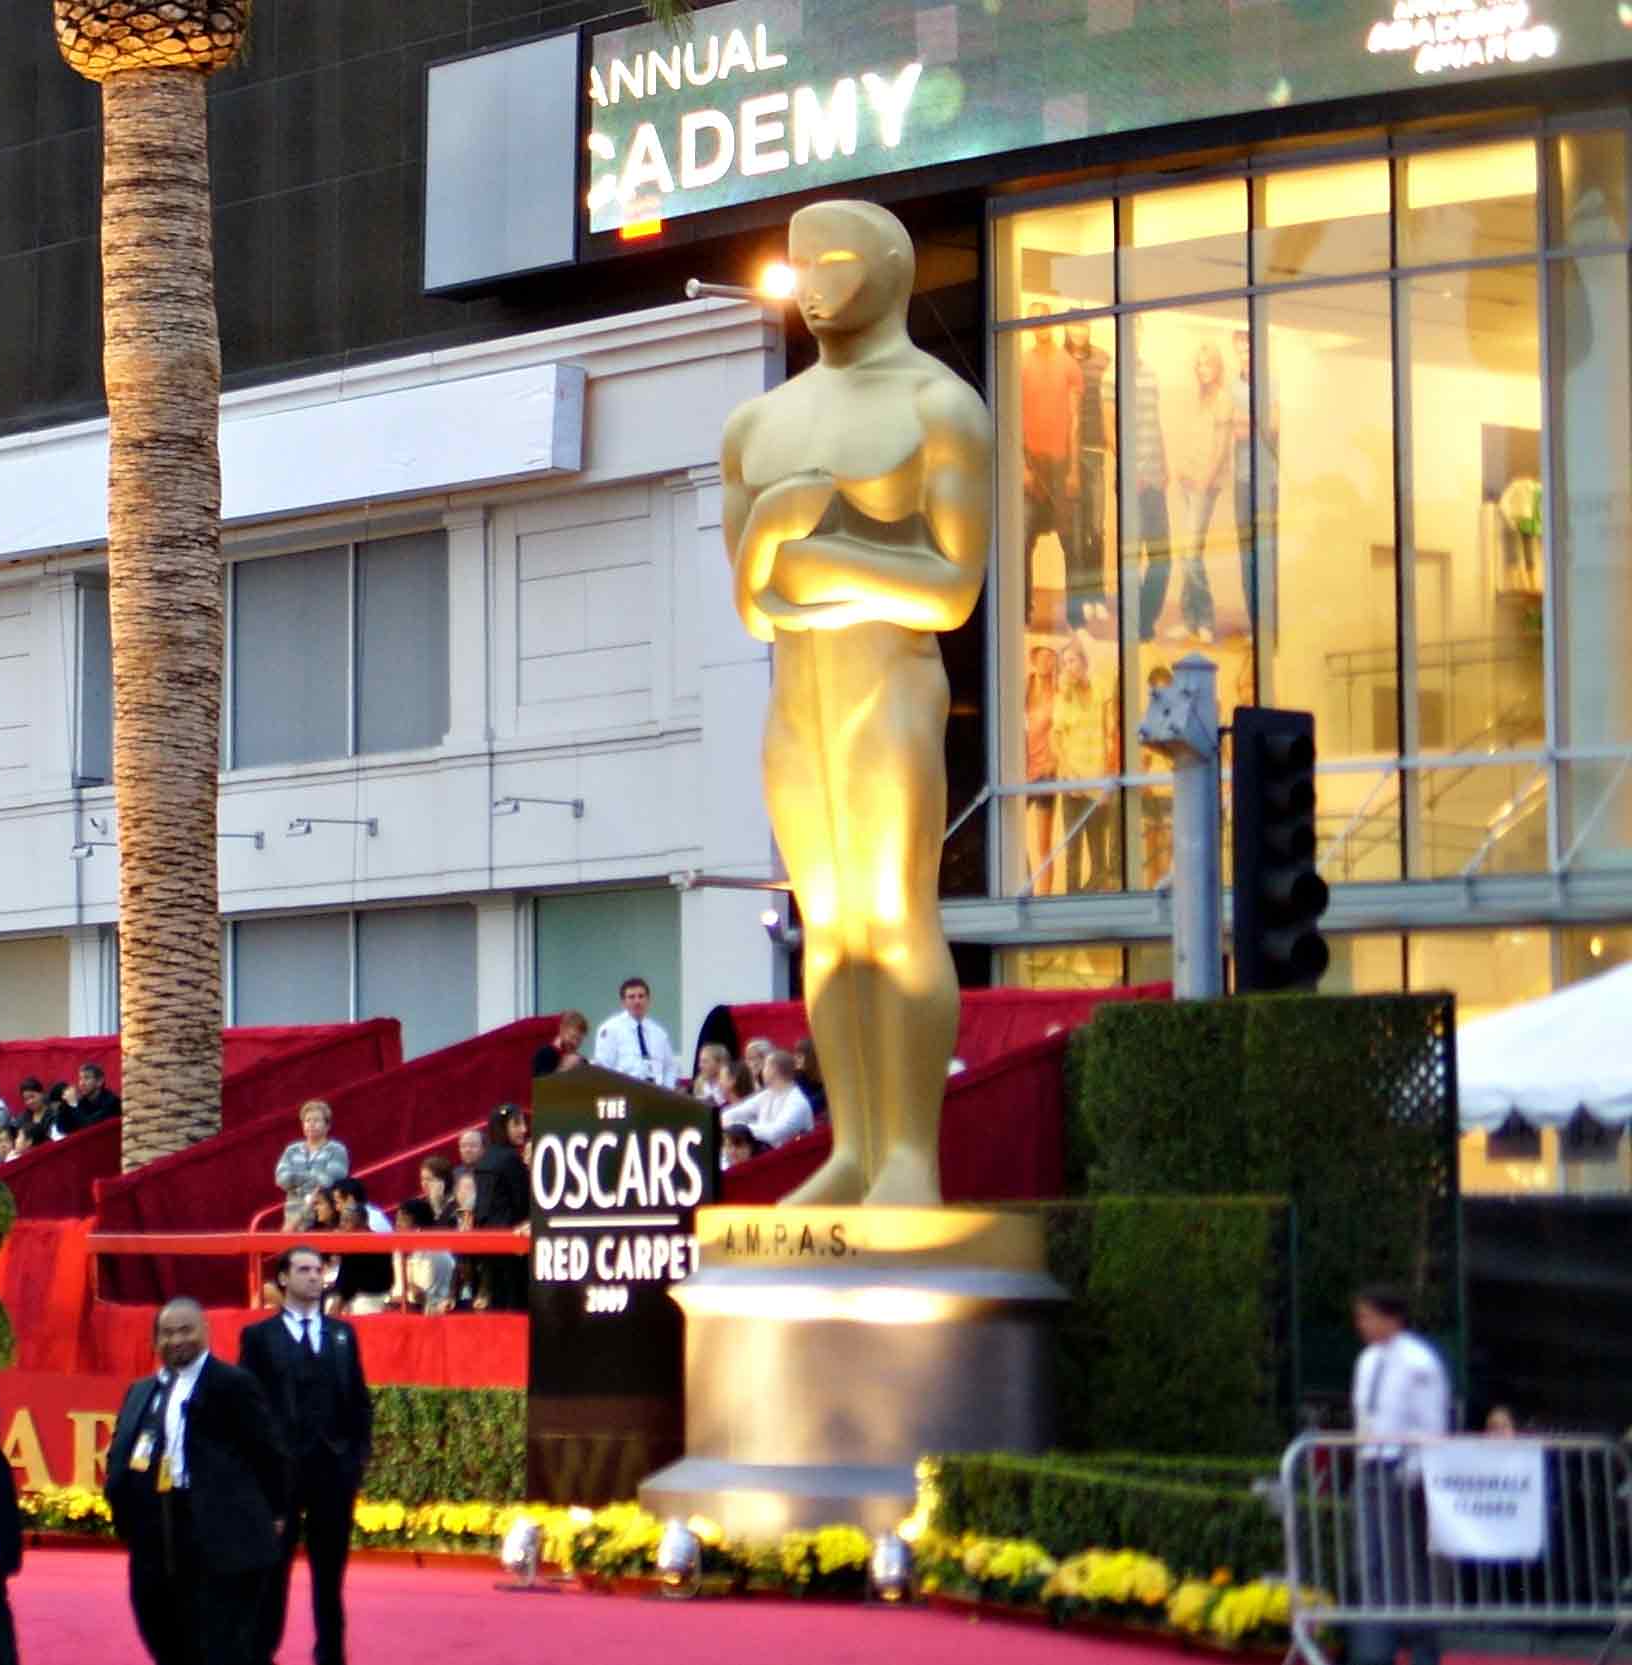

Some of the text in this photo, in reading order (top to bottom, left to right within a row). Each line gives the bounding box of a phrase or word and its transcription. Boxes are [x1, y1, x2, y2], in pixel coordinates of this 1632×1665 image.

[596, 1097, 627, 1119] THE
[532, 1127, 703, 1210] OSCARS
[725, 1223, 858, 1257] A.M.P.A.S.
[535, 1235, 700, 1281] RED CARPET
[585, 1286, 629, 1313] 2009
